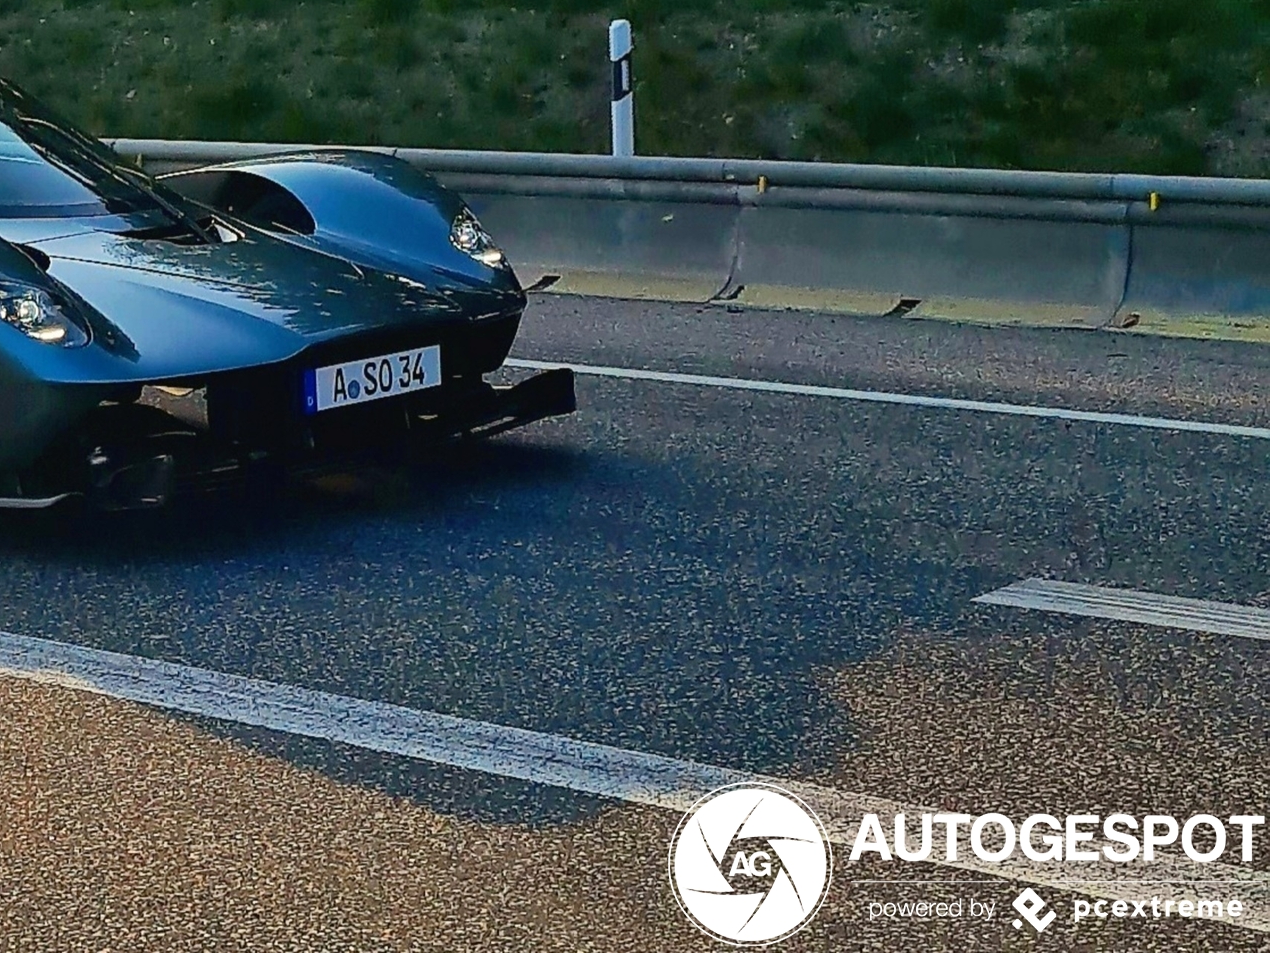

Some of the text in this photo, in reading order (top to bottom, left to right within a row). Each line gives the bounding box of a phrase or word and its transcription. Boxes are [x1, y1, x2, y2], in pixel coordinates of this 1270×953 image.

[333, 352, 425, 402] A SO 34
[307, 396, 314, 406] D
